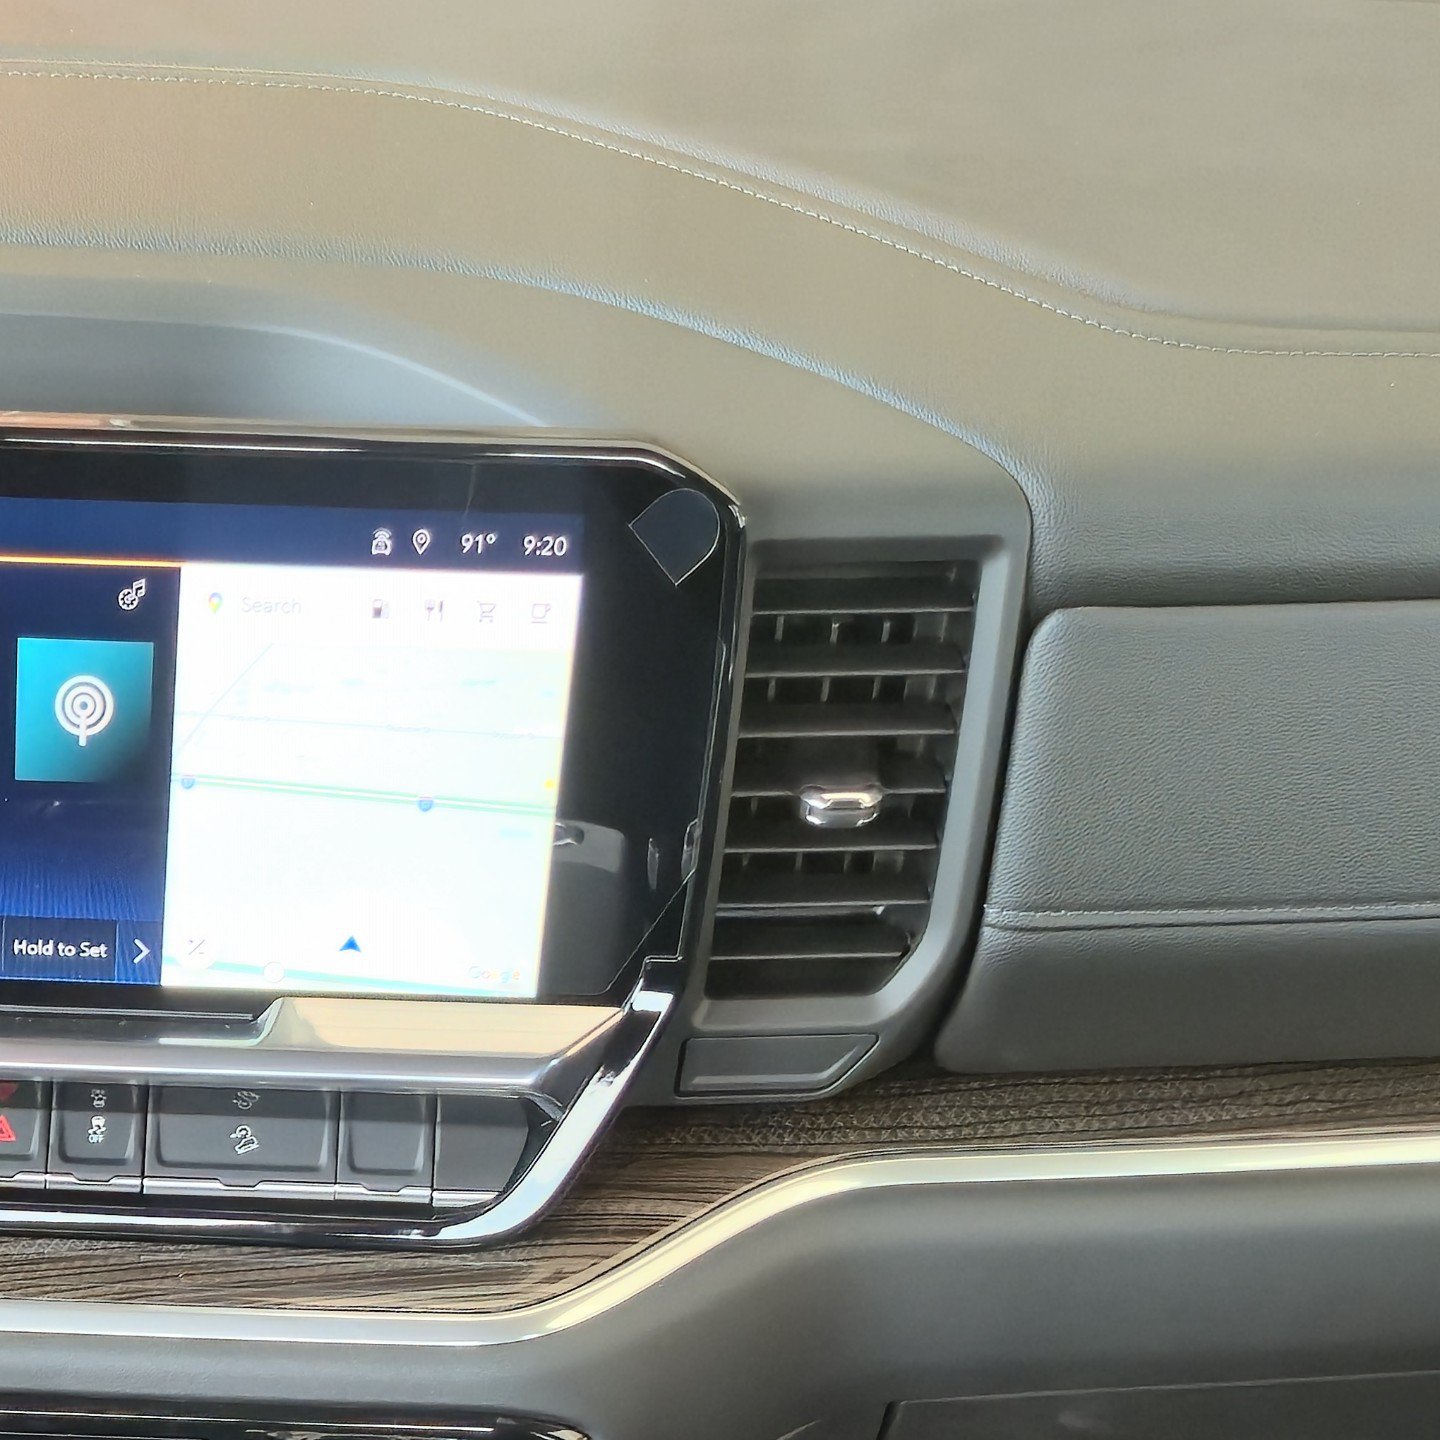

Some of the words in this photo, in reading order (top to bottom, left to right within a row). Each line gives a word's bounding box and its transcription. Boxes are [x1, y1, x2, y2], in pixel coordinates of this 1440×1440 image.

[461, 532, 497, 554] 91°
[523, 536, 567, 556] 9:20
[241, 595, 303, 616] Search
[13, 939, 53, 958] Hold
[57, 941, 77, 958] to
[80, 942, 108, 959] Set
